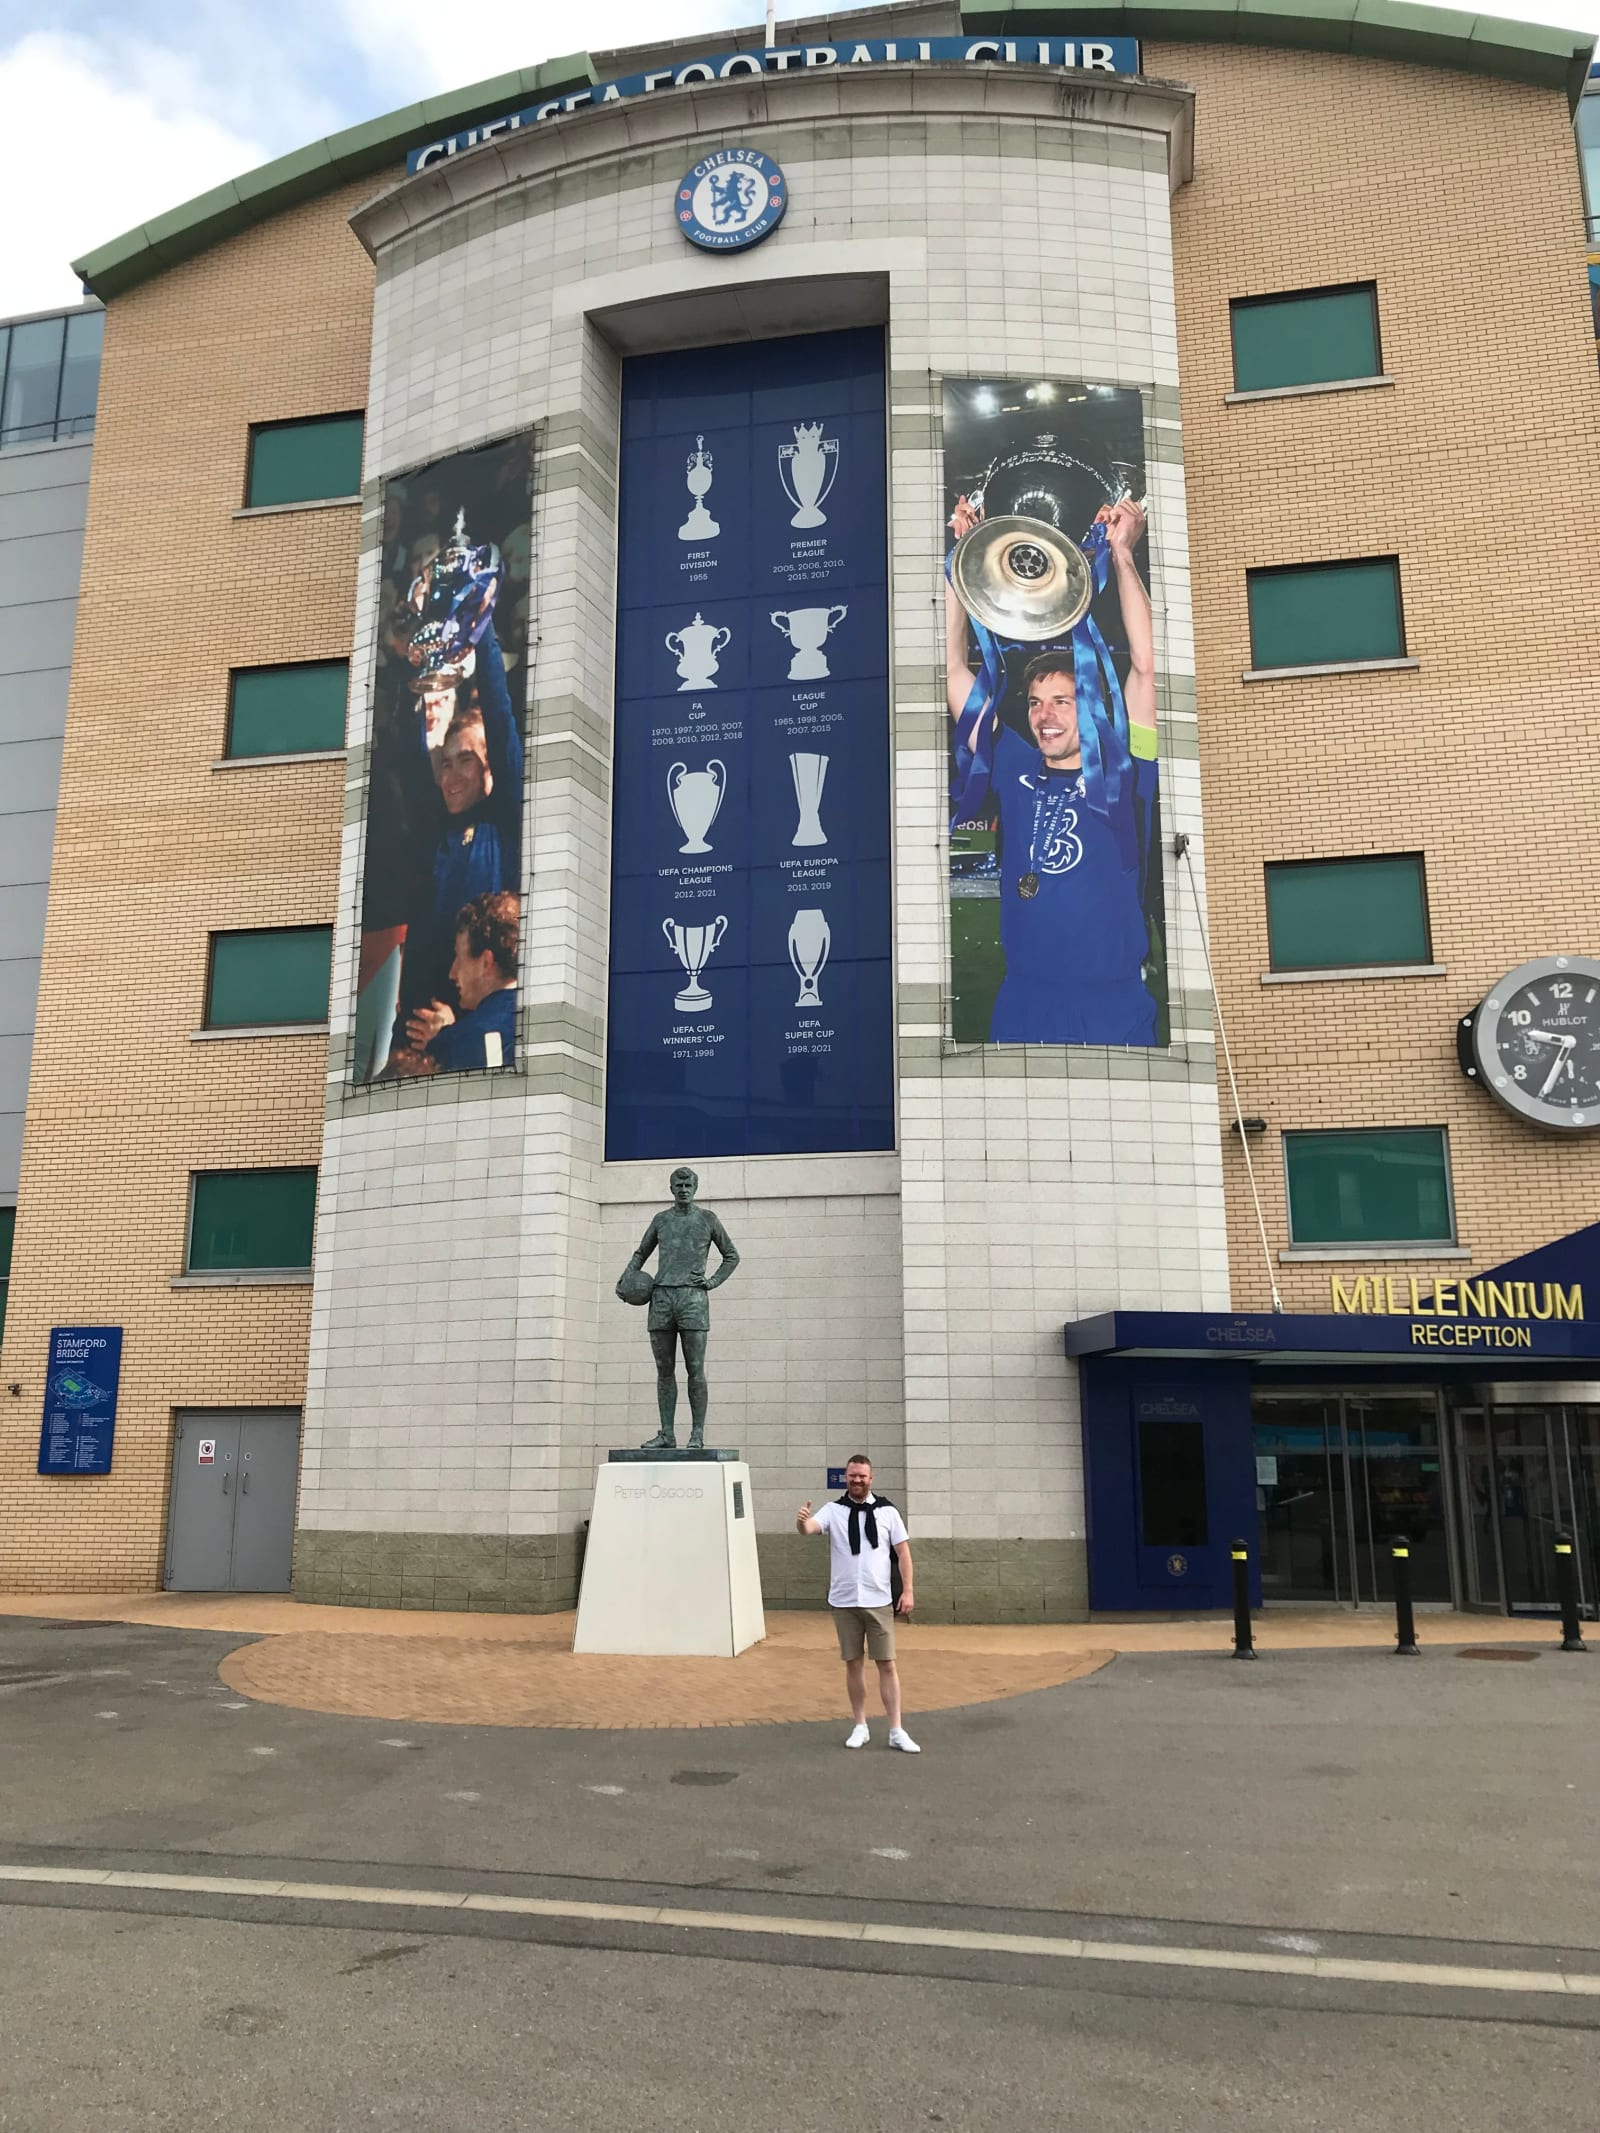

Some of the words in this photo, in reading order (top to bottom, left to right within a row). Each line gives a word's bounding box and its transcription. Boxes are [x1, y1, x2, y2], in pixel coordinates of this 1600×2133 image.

[694, 150, 764, 177] CHELSEA
[694, 230, 741, 244] FOOTBALL
[745, 219, 768, 238] CLUB
[791, 539, 827, 549] PREMIER
[687, 551, 711, 560] FIRST
[792, 549, 825, 559] LEAGUE
[680, 560, 718, 570] DIVISION
[689, 574, 708, 582] 1955
[810, 571, 830, 579] 2017
[792, 692, 826, 702] LEAGUE
[800, 702, 818, 711] CUP
[688, 712, 706, 720] CUP
[811, 724, 831, 733] 2015
[723, 731, 743, 740] 2018
[954, 820, 988, 831] epsi
[780, 860, 802, 869] UEFA
[803, 857, 839, 867] EUROPA
[658, 867, 680, 876] UEFA
[681, 865, 733, 875] CHAMPIONS
[792, 869, 826, 878] LEAGUE
[679, 876, 713, 885] LEAGUE
[811, 882, 832, 890] 2019
[697, 889, 716, 897] 2021
[1549, 983, 1574, 999] 12
[1507, 1010, 1531, 1026] 10
[1542, 1016, 1589, 1027] HUBLOT
[672, 1026, 695, 1034] UEFA
[697, 1024, 715, 1033] CUP
[798, 1020, 821, 1028] UEFA
[706, 1035, 725, 1043] CUP
[785, 1031, 813, 1039] SUPER
[816, 1029, 835, 1038] CUP
[694, 1049, 714, 1057] 1998
[811, 1044, 832, 1052] 2021
[1513, 1065, 1527, 1080] 8
[1330, 1275, 1585, 1320] MILLENNIUM
[1206, 1327, 1277, 1342] CHELSEA
[1411, 1324, 1532, 1348] RECEPTION
[56, 1339, 107, 1349] STAMFORD
[56, 1349, 90, 1358] BRIDGE
[1140, 1403, 1199, 1415] CHELSEA
[614, 1485, 647, 1499] PETER
[649, 1484, 704, 1499] OSGOOD
